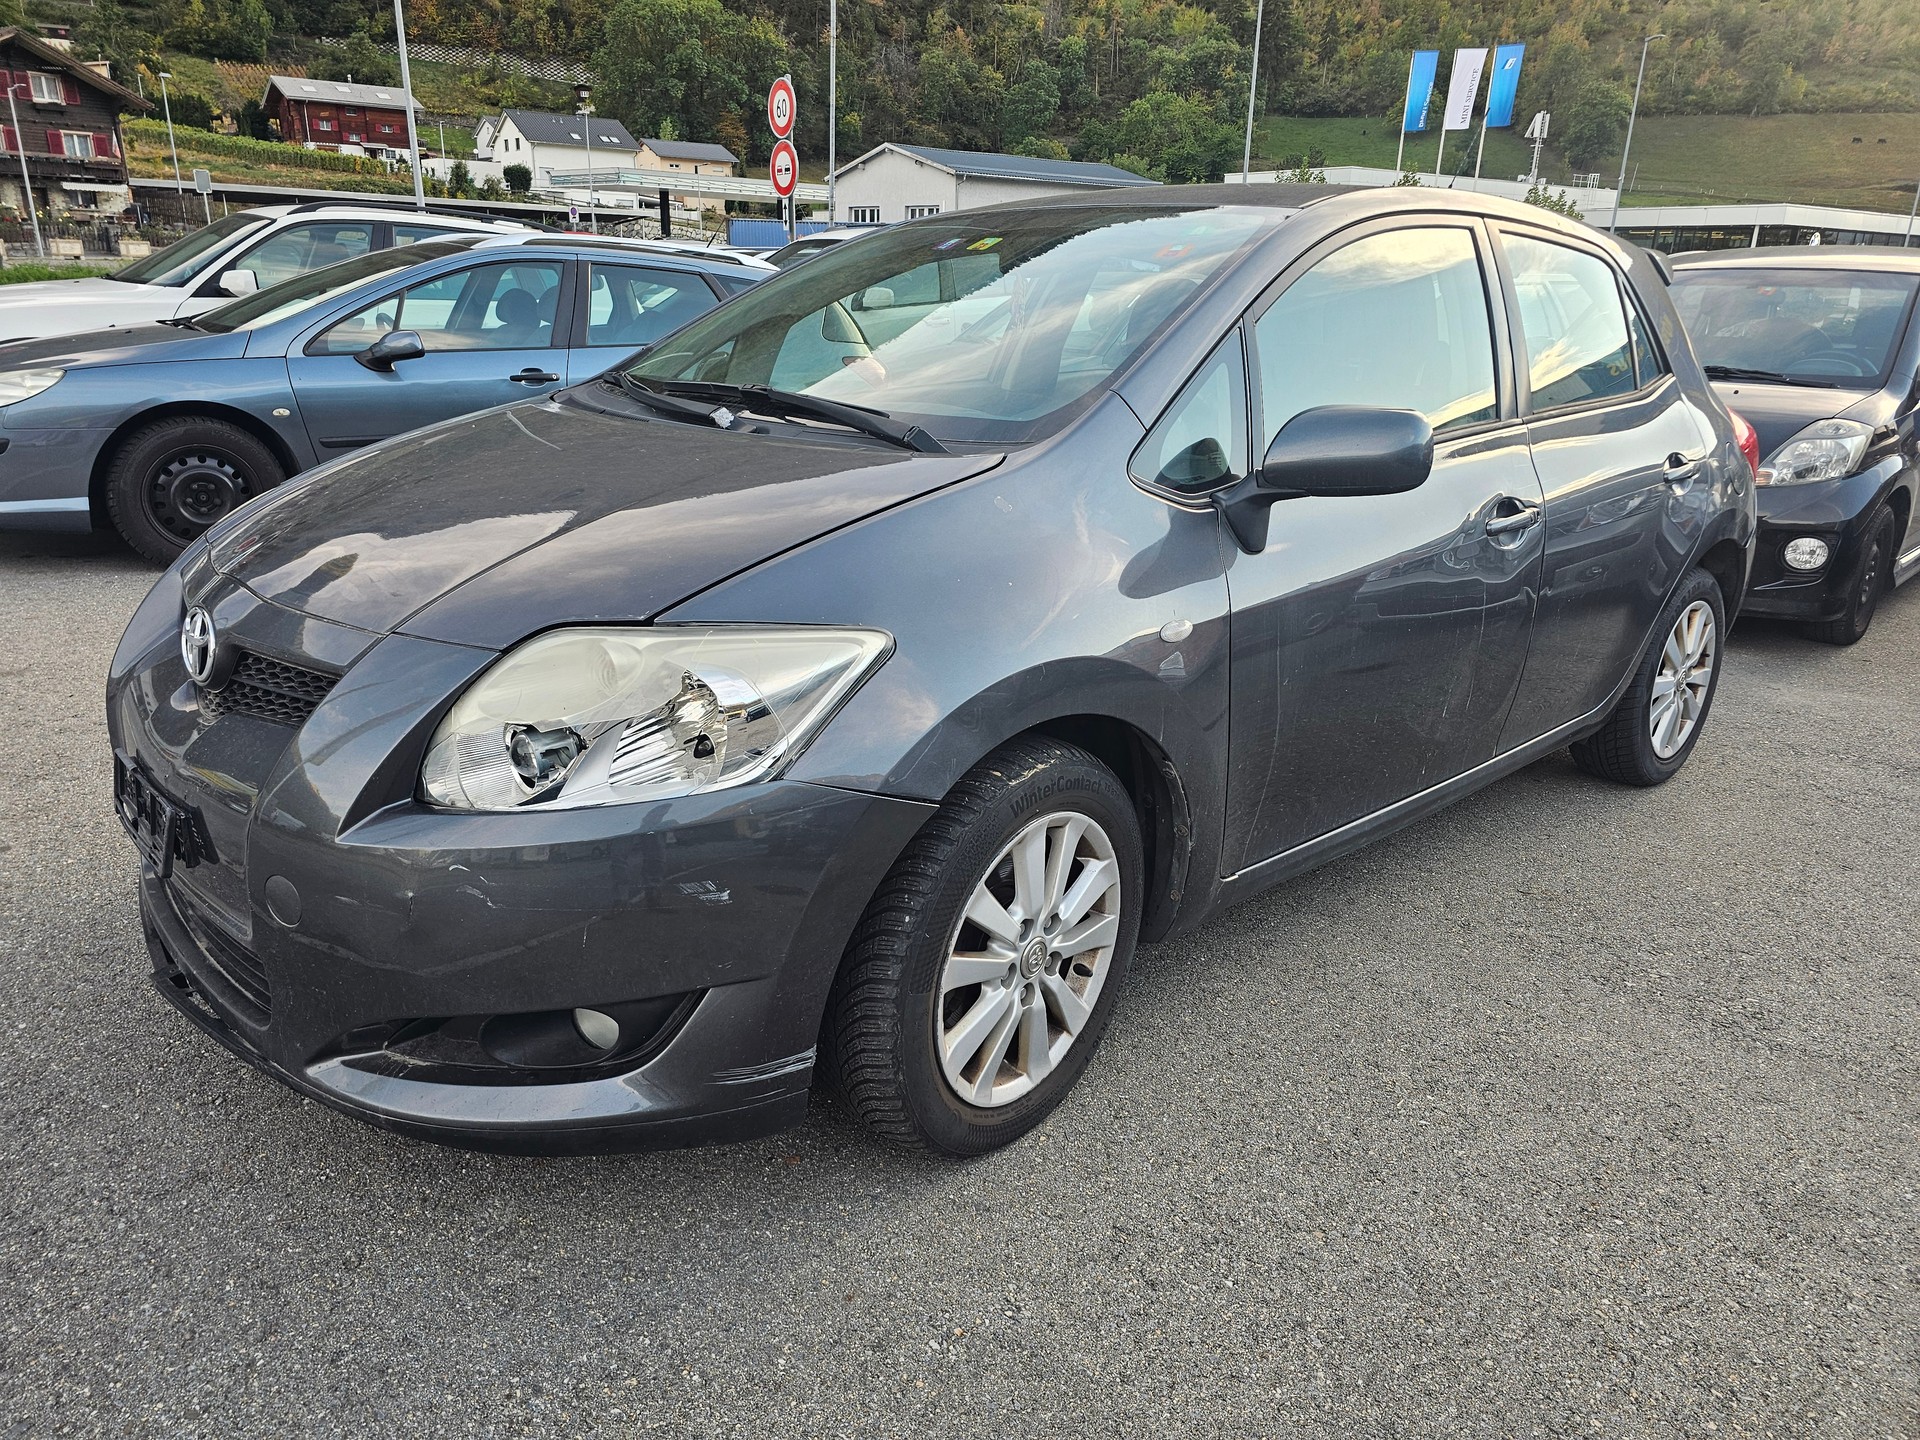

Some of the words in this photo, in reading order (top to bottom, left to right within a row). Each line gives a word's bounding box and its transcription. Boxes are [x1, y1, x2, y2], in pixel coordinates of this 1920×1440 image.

[776, 98, 786, 118] 60
[1460, 105, 1469, 124] MINI
[1466, 68, 1480, 103] SERVICE
[1010, 775, 1102, 818] WinterContact
